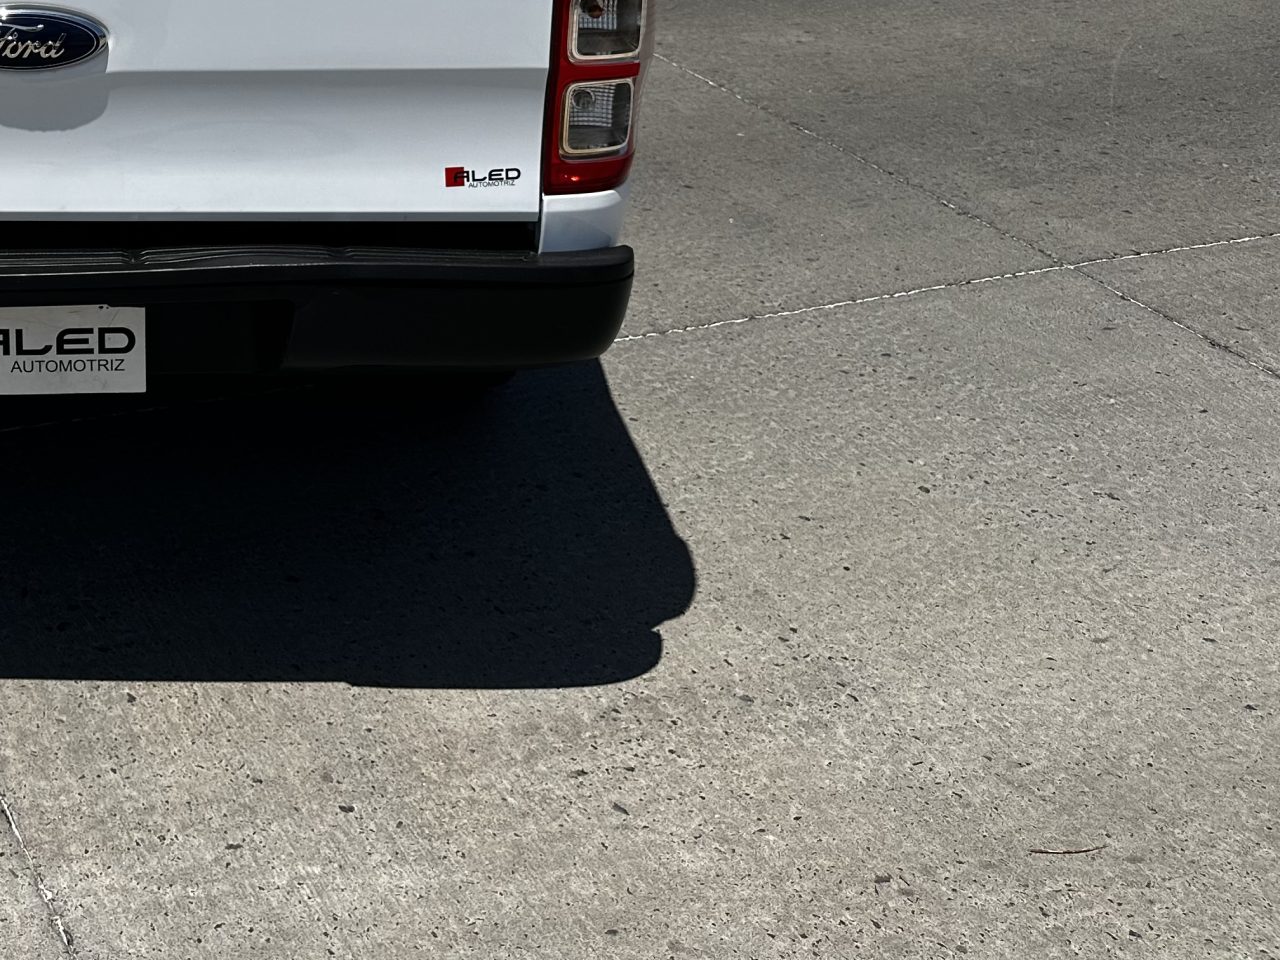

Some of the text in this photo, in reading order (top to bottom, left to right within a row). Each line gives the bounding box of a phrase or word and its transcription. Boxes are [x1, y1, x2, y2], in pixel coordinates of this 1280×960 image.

[454, 167, 521, 182] ALED
[468, 179, 517, 188] AUTOMOTRIZ
[10, 359, 125, 373] AUTOMOTRIZ
